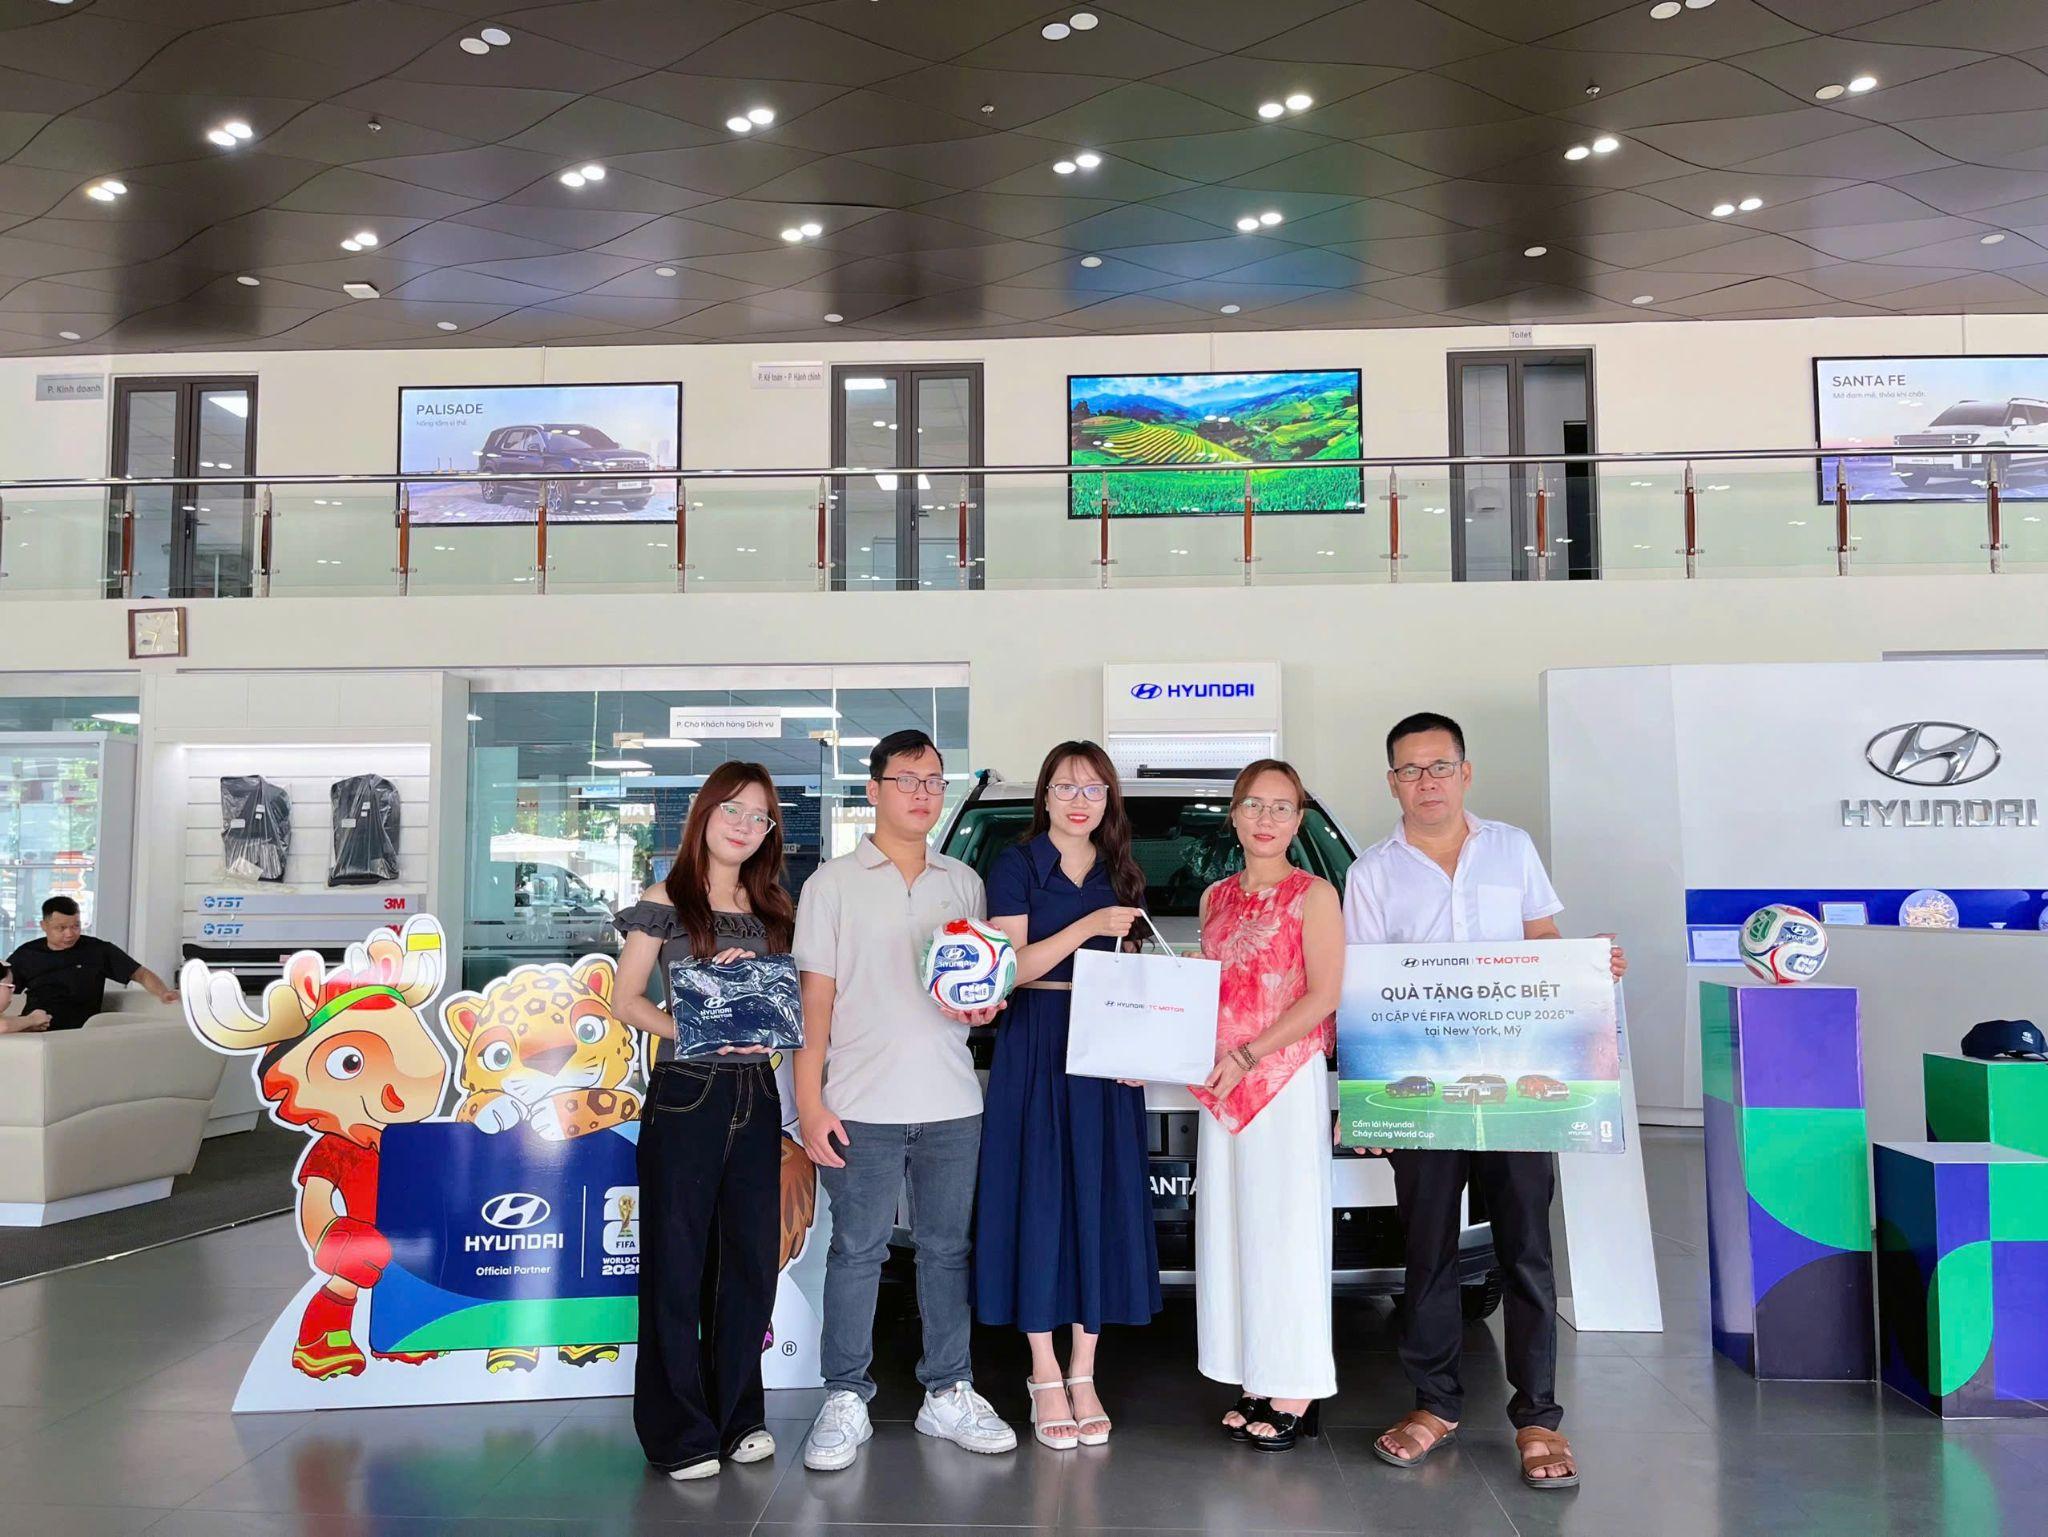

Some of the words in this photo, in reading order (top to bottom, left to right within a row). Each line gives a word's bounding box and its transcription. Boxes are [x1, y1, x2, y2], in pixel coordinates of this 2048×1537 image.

[1511, 331, 1531, 339] Toilet
[1832, 375, 1885, 387] SANTA
[1888, 374, 1906, 386] FE
[47, 386, 54, 394] P.
[57, 385, 74, 393] Kinh
[77, 384, 101, 393] doanh
[416, 403, 484, 415] PALISADE
[1168, 684, 1254, 697] HYUNDAI
[726, 721, 745, 729] hàng
[747, 720, 763, 729] Dịch
[1841, 799, 2040, 827] HYUNDAI
[384, 898, 406, 909] 3M
[1422, 957, 1469, 967] HYUNDAI
[1476, 956, 1491, 965] TC
[1493, 956, 1540, 964] MOTOR
[1381, 983, 1420, 1002] QUÀ
[1423, 983, 1473, 1003] TẶNG
[1477, 982, 1516, 1002] ĐẶC
[1521, 980, 1560, 1001] BIỆT
[700, 1007, 732, 1015] HYUNDAI
[1371, 1012, 1383, 1022] 01
[1411, 1010, 1427, 1021] VÉ
[1430, 1012, 1454, 1021] FIFA
[1457, 1011, 1503, 1021] WORLD
[1506, 1010, 1531, 1020] CUP
[1425, 1026, 1440, 1037] tại
[1443, 1026, 1469, 1036] New
[1472, 1026, 1501, 1036] York,
[1503, 1025, 1522, 1037] Mỹ
[1382, 1121, 1415, 1129] Hyundai
[1418, 1131, 1435, 1140] Cup
[465, 1233, 564, 1252] HYUNDAI
[476, 1266, 512, 1276] Official
[514, 1266, 550, 1275] Partner
